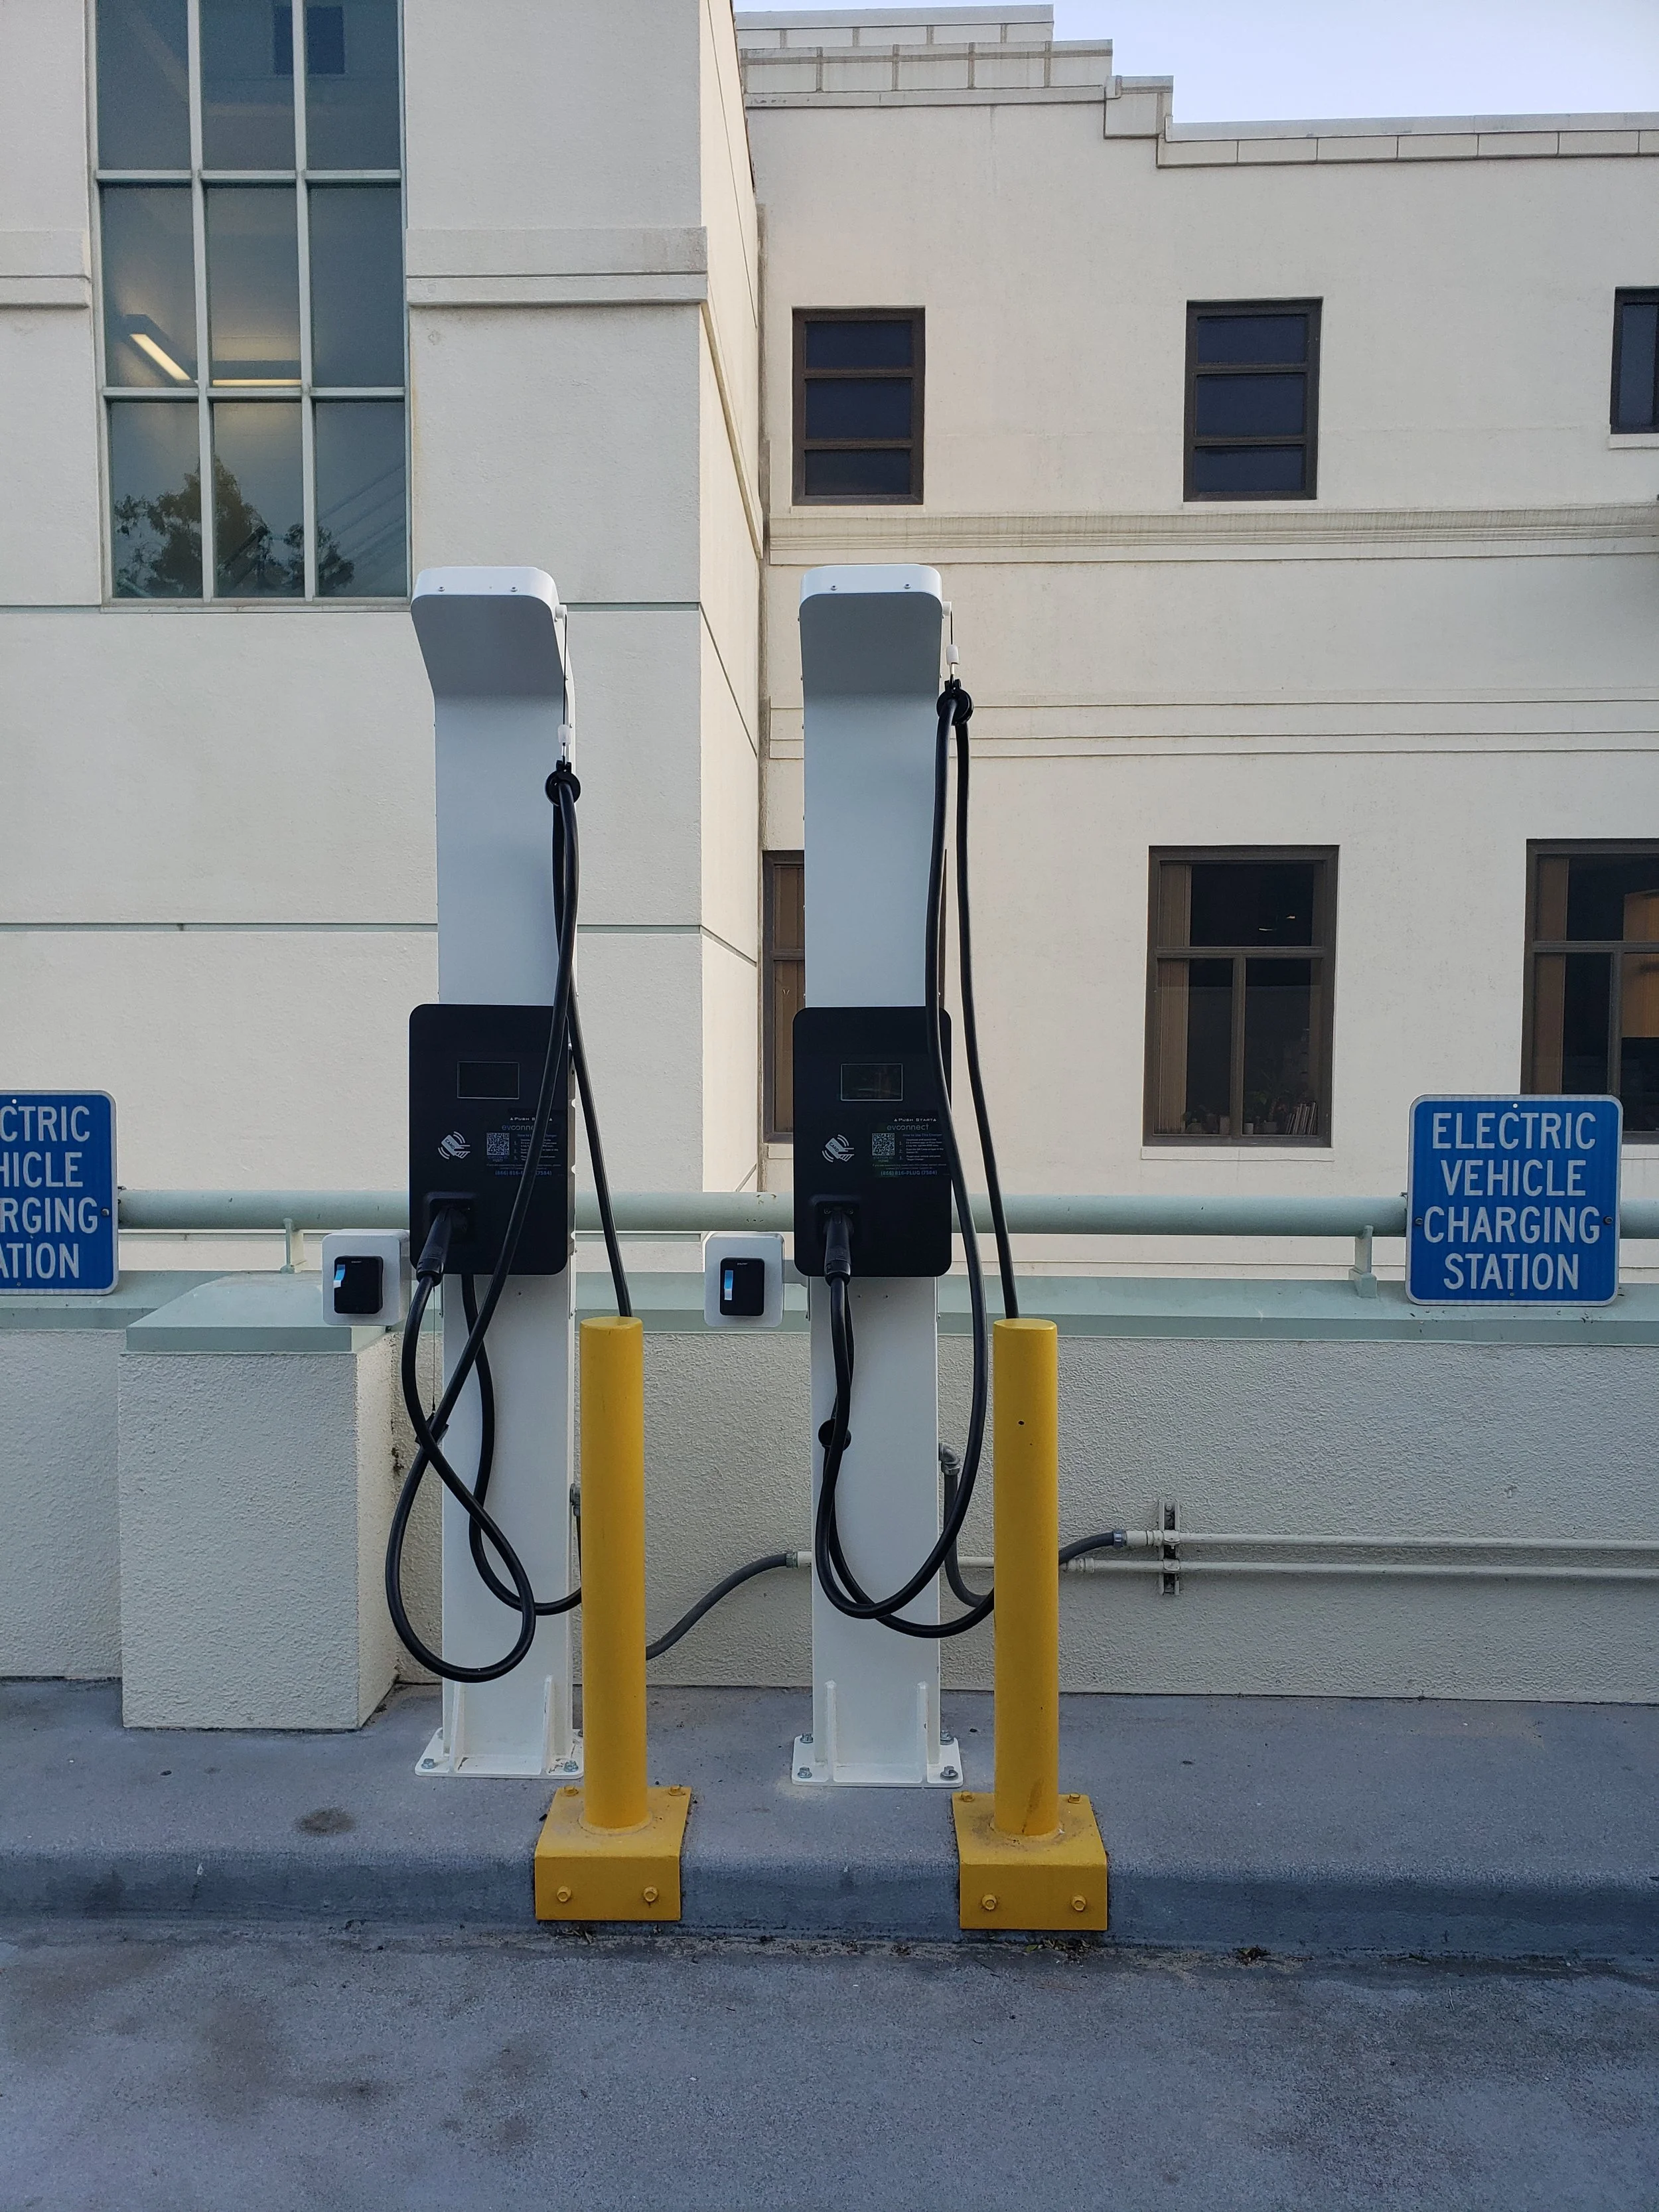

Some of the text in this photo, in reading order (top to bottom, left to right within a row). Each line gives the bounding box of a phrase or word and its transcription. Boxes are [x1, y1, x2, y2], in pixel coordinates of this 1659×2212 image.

[829, 1142, 839, 1152] CARD
[1432, 1112, 1596, 1149] ELECTRIC
[1440, 1159, 1586, 1197] VEHICLE
[1424, 1206, 1600, 1244] CHARGING
[1443, 1252, 1579, 1290] STATION
